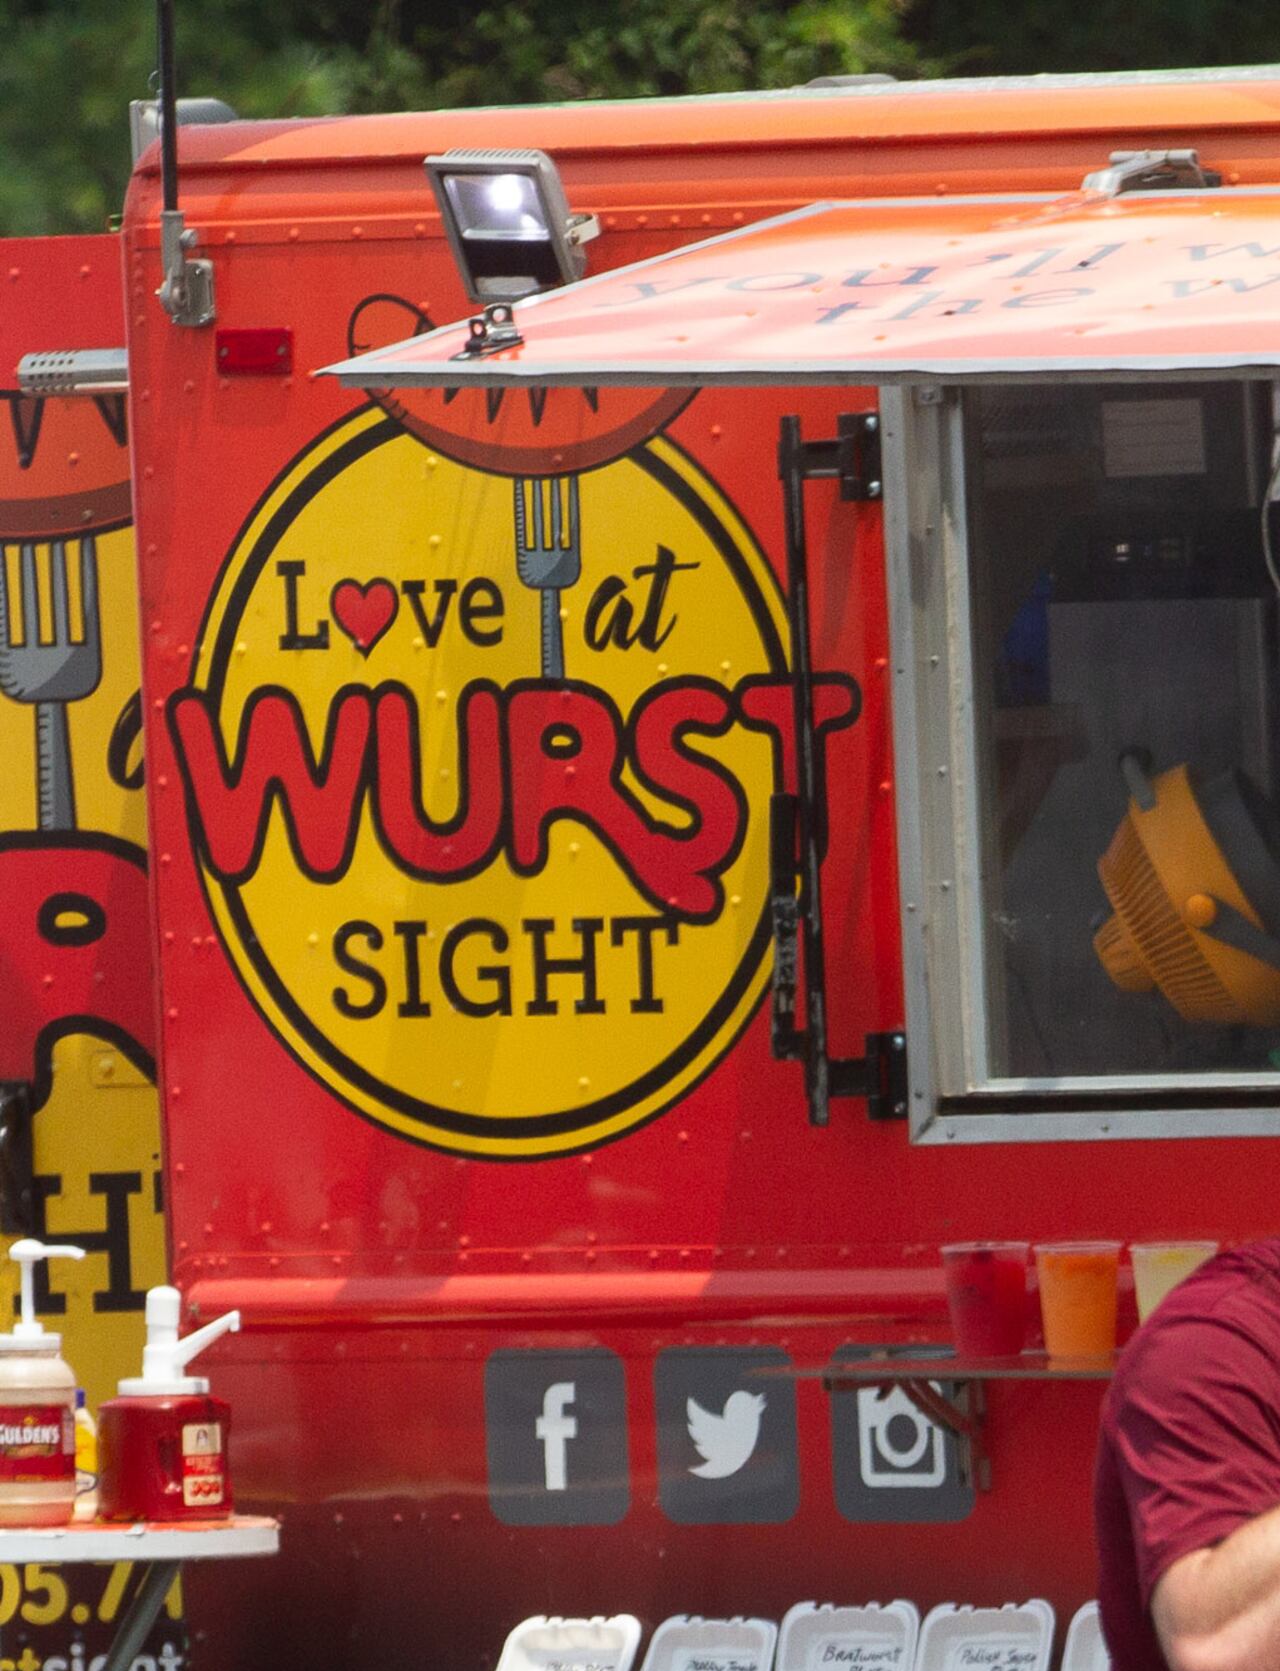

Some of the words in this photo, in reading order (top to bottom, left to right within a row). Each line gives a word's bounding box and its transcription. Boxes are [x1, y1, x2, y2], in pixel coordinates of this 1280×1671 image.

[594, 241, 1126, 309] you'll
[814, 282, 1097, 325] the
[583, 544, 700, 653] at
[167, 672, 862, 925] WURST
[330, 916, 681, 1019] SIGHT
